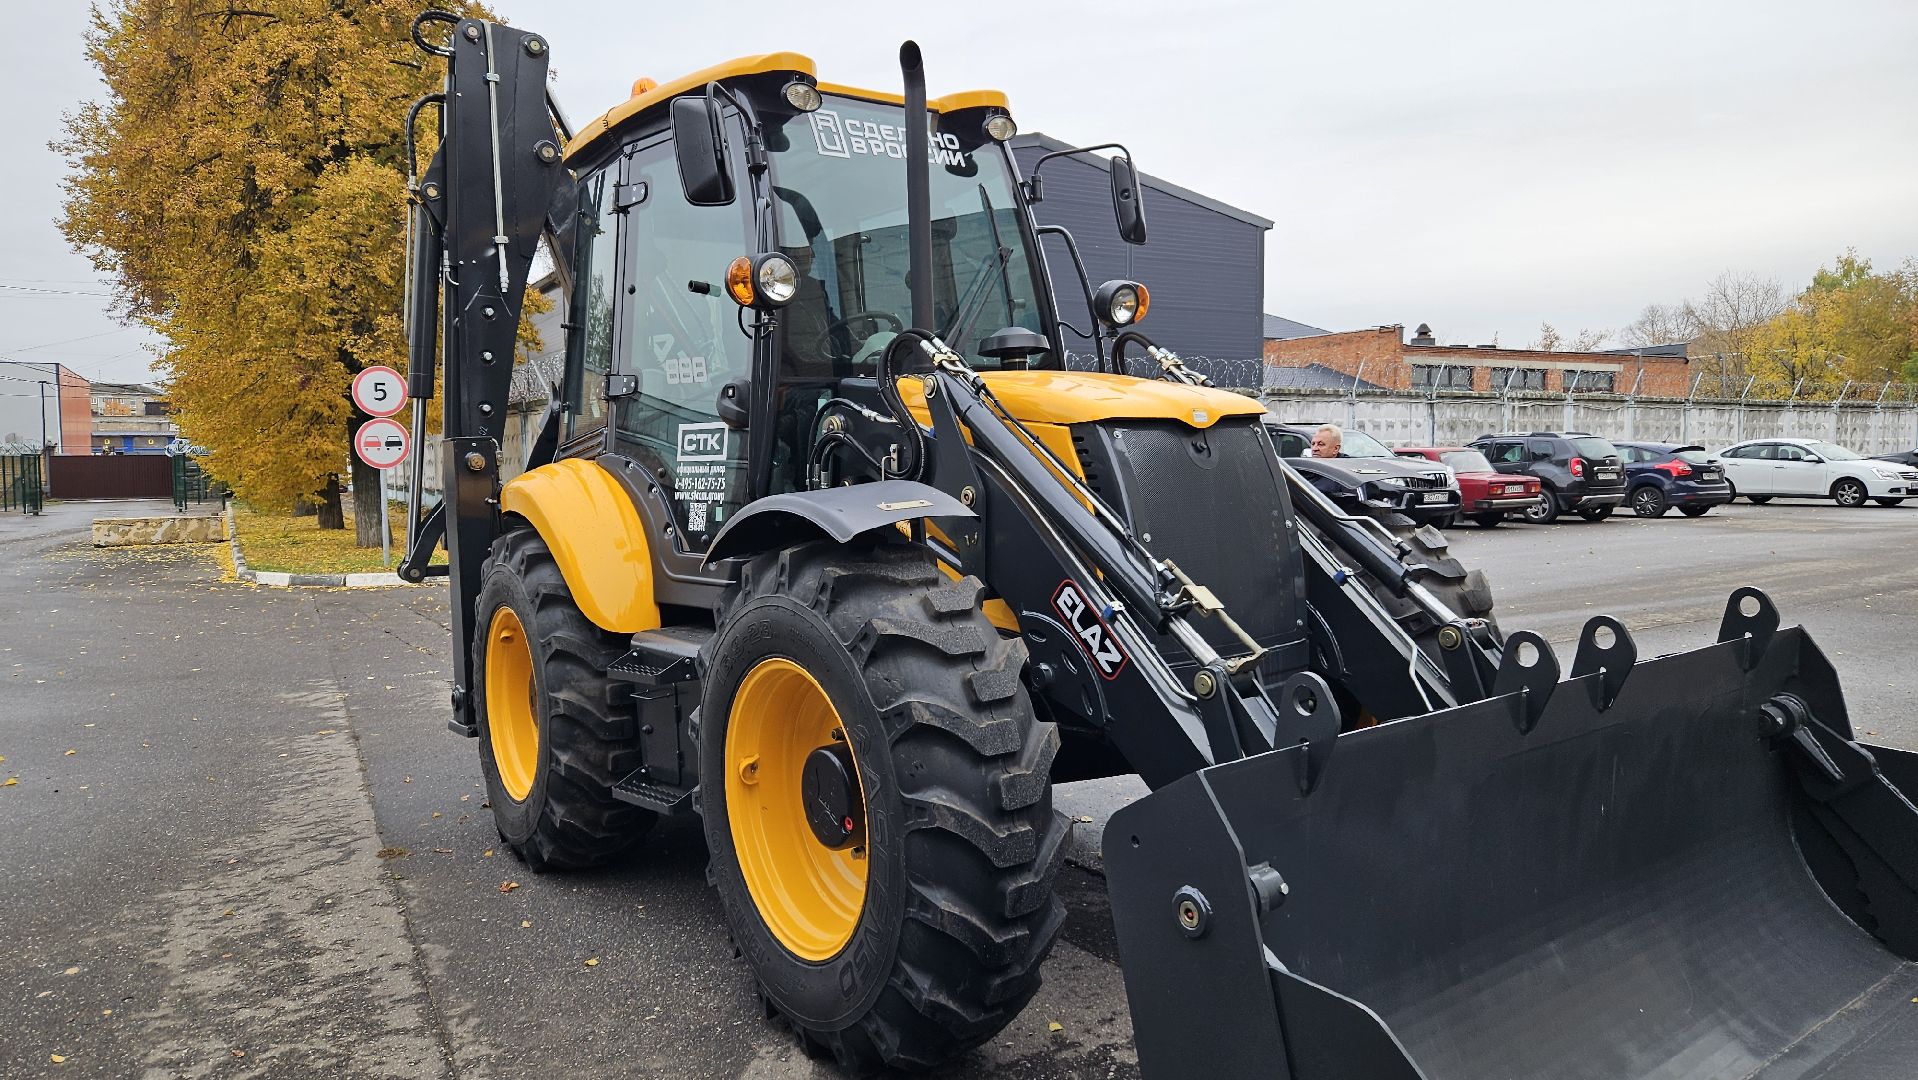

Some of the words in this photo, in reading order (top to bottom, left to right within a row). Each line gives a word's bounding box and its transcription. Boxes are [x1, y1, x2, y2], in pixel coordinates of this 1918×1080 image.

[844, 118, 961, 150] СДЕЛНО
[373, 382, 387, 401] 5
[683, 432, 721, 452] СТК
[674, 477, 726, 490] 8-495-162-75-75
[1056, 585, 1123, 674] ELAZ
